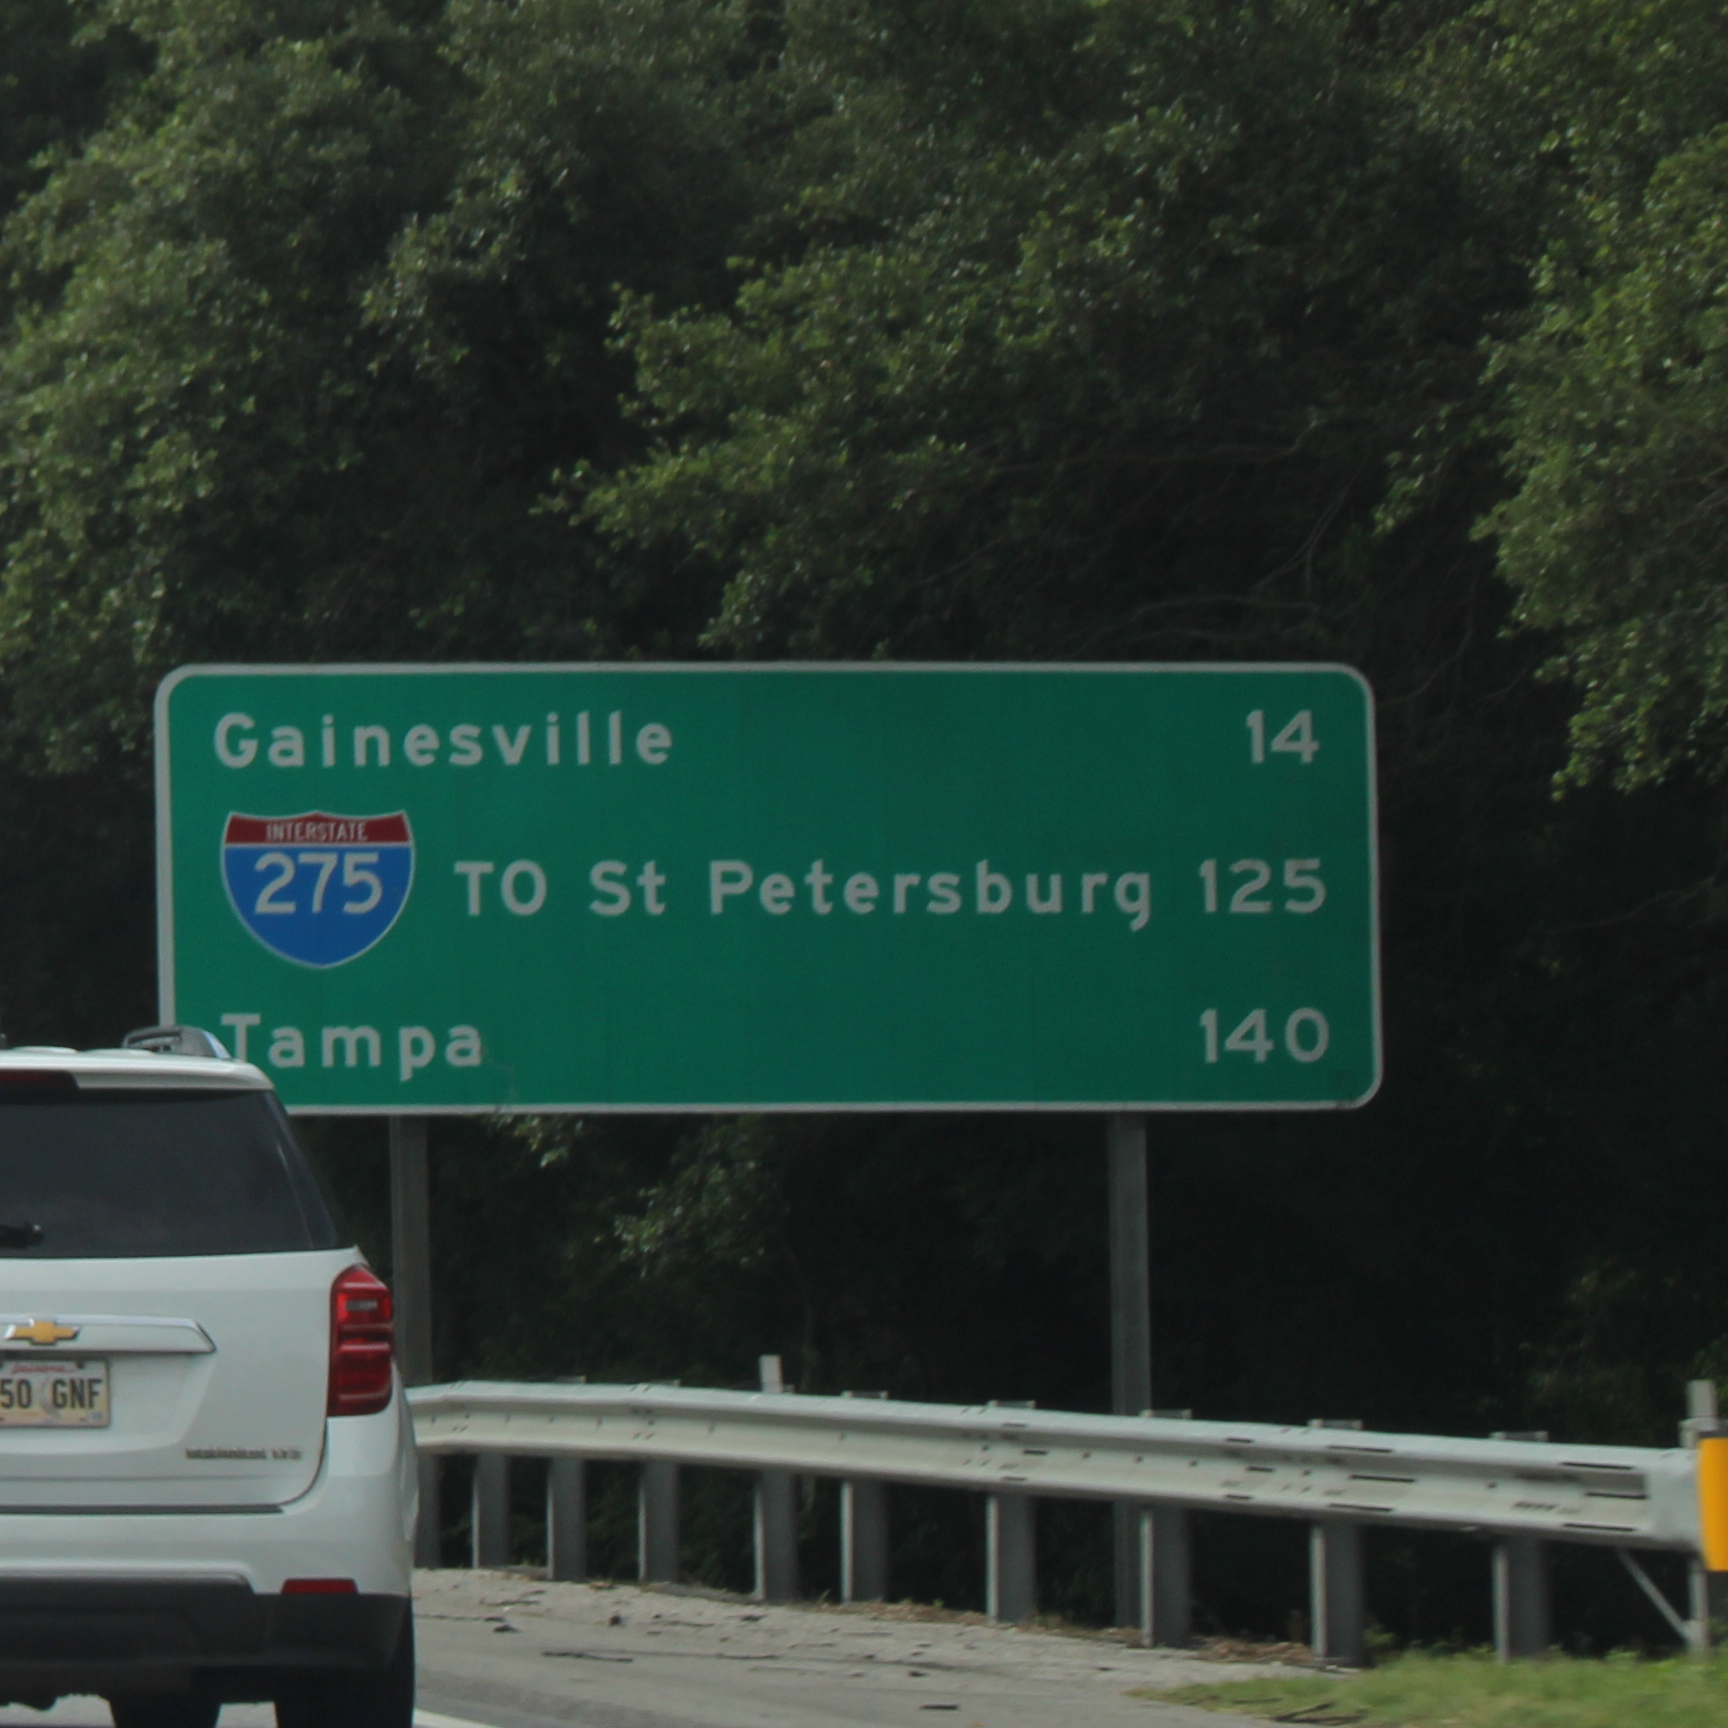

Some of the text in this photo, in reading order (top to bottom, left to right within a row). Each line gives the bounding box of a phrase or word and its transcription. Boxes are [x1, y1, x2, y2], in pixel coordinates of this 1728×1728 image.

[213, 708, 1321, 769] Gainesville 14
[265, 821, 368, 842] INTERSTATE
[254, 851, 383, 915] 275
[453, 857, 1327, 933] TO St Petersburg 125
[220, 1006, 1331, 1083] Tampa 140
[50, 1377, 104, 1410] GNF
